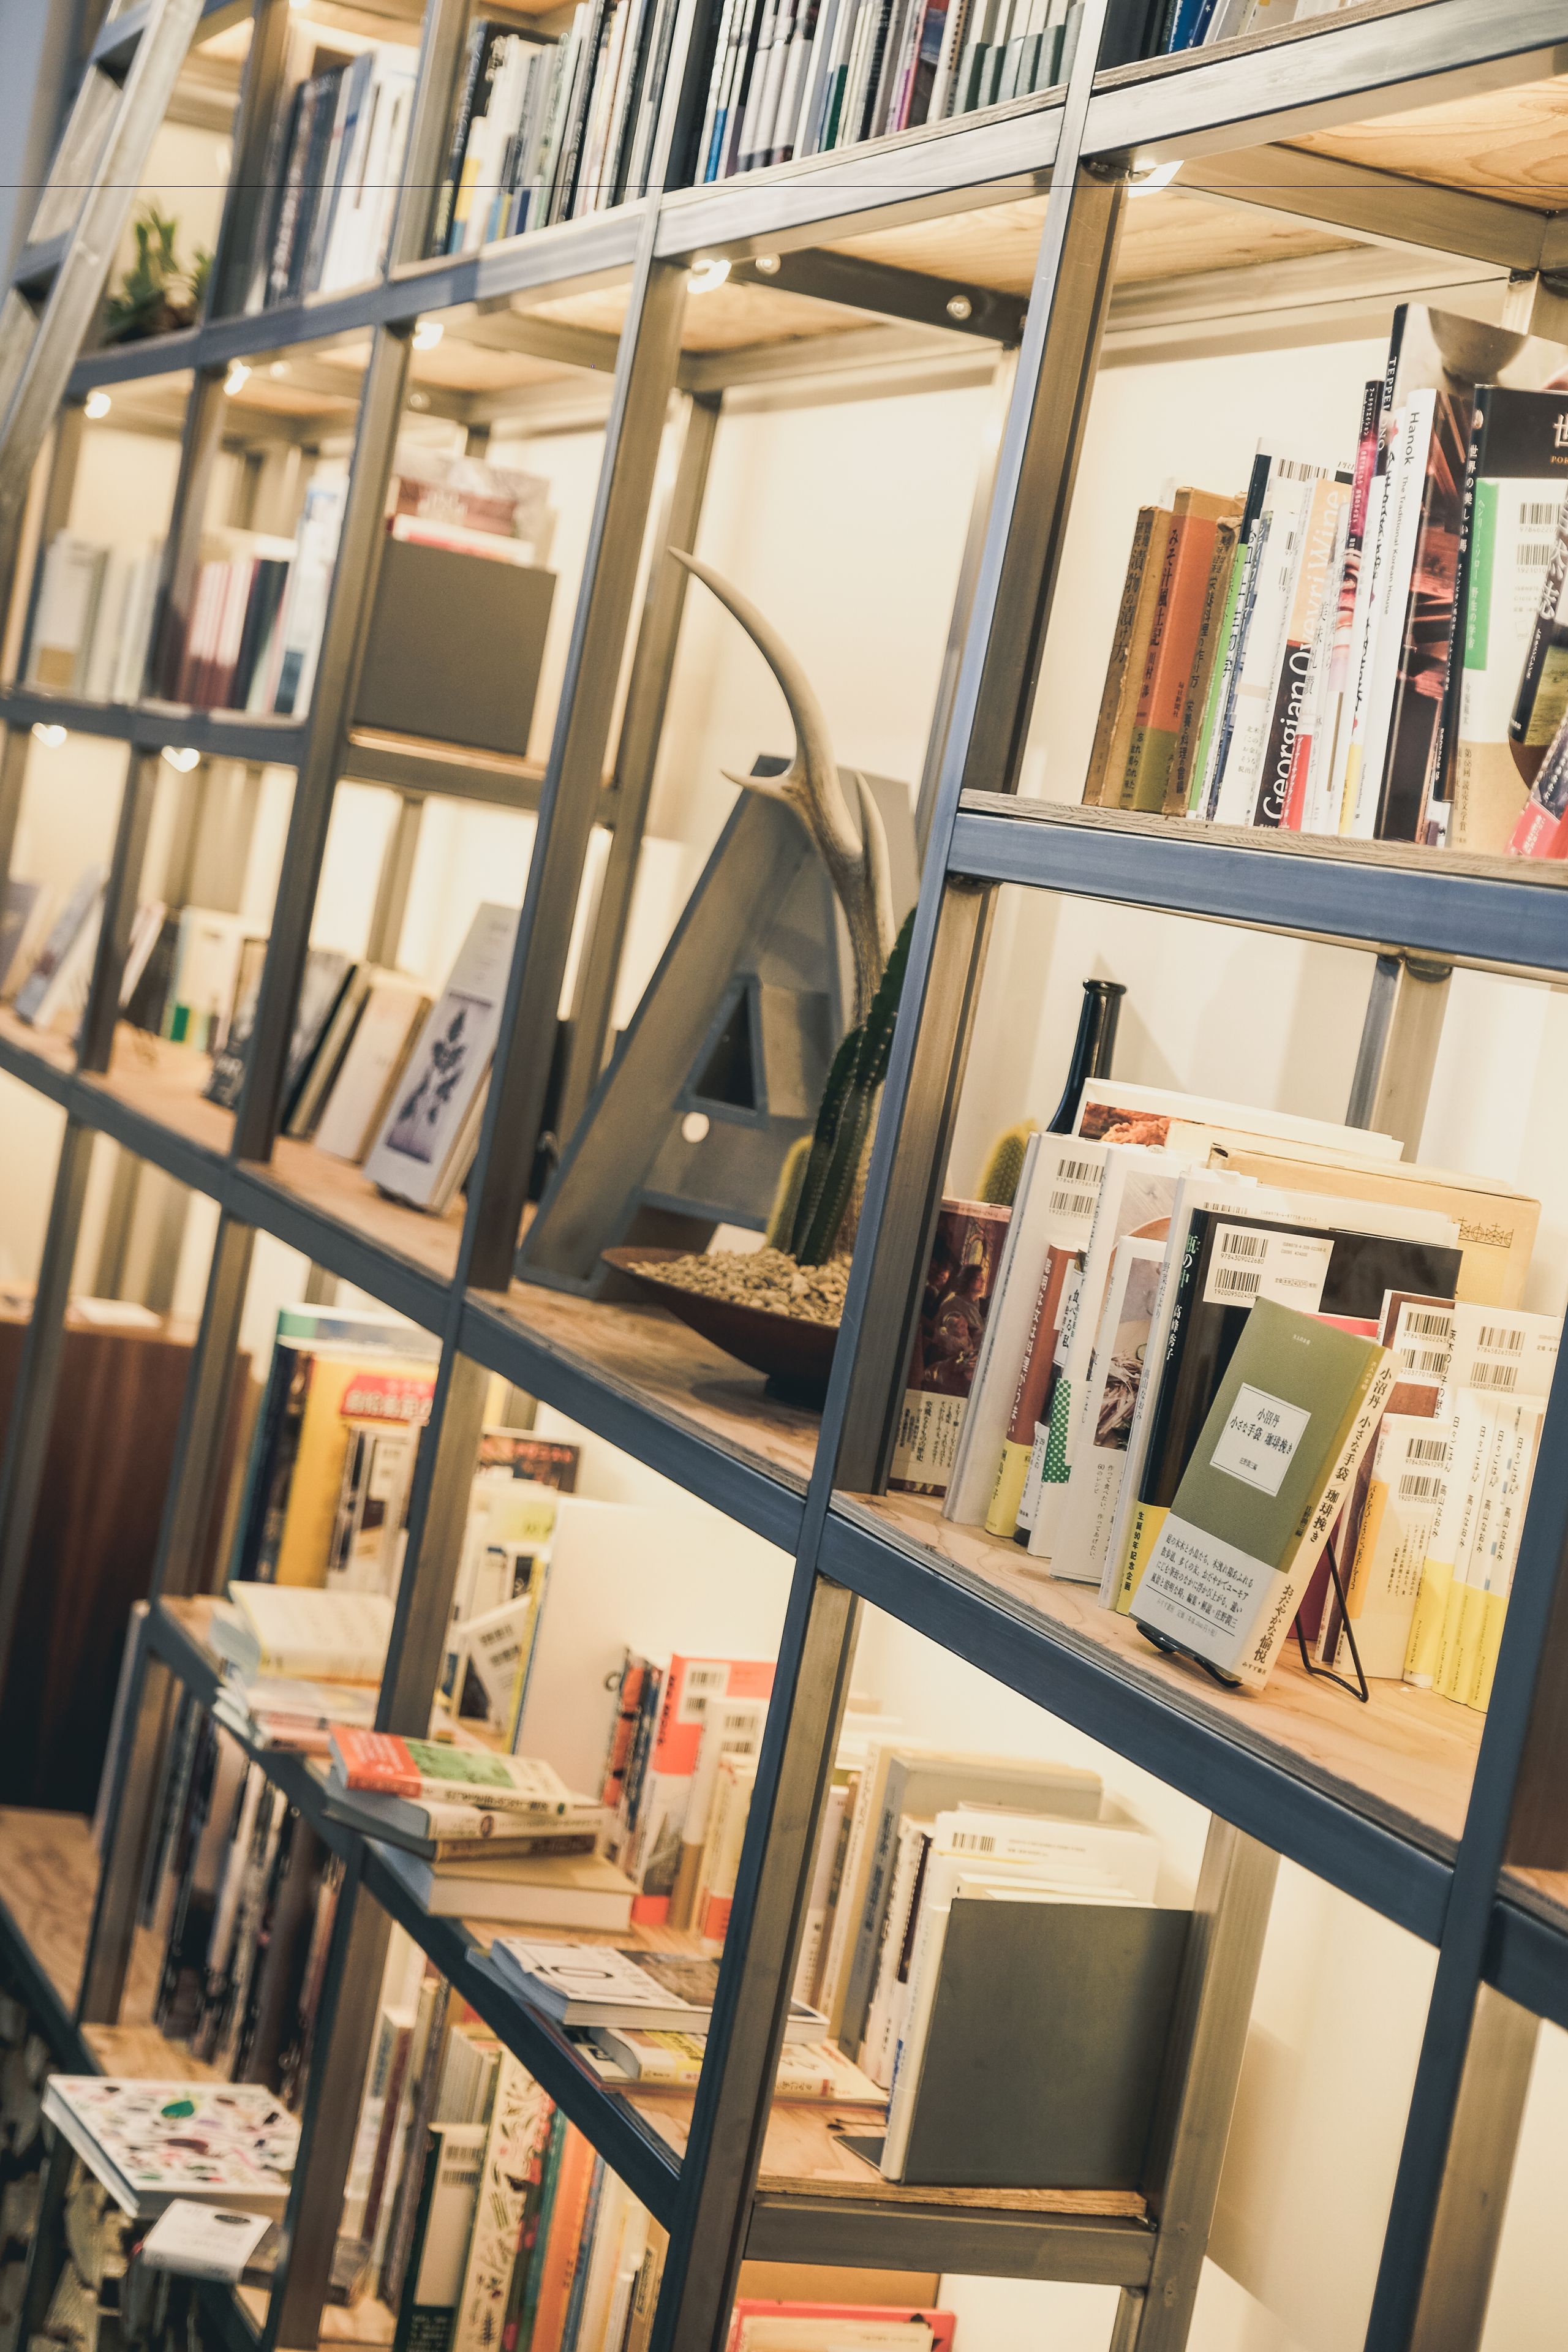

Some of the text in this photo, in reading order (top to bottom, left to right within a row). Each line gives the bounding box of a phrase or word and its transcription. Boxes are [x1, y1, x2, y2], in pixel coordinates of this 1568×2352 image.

[1378, 356, 1397, 451] TEPPEI ONO
[1404, 412, 1420, 466] Hanok
[1393, 497, 1406, 546] Traditional
[1459, 444, 1479, 552] 世界の美しい馬
[1389, 549, 1398, 582] Korean
[1474, 499, 1485, 581] ヘンリー・ソロー
[1111, 548, 1147, 663] 漬物の漬け方
[1148, 529, 1179, 646] みそ汁風土記
[1384, 585, 1395, 615] House
[1262, 682, 1306, 820] Georgian
[1308, 490, 1340, 570] Wine
[1304, 602, 1329, 695] 美味礼讃
[1220, 1253, 1264, 1265] 9784309022680
[1166, 1234, 1197, 1361] 瓶の中 高峰秀子
[1367, 1367, 1392, 1409] 小沼丹
[1256, 1408, 1280, 1428] 小沼丹
[1444, 1416, 1460, 1473] 日々ごはん
[1471, 1426, 1487, 1483] 日々ごはん
[1488, 1430, 1505, 1488] 日々ごはん
[1509, 1437, 1524, 1494] 日々ごはん
[1124, 1511, 1145, 1591] 生誕90年記念企画
[1254, 1583, 1295, 1664] おだやかな愉悦
